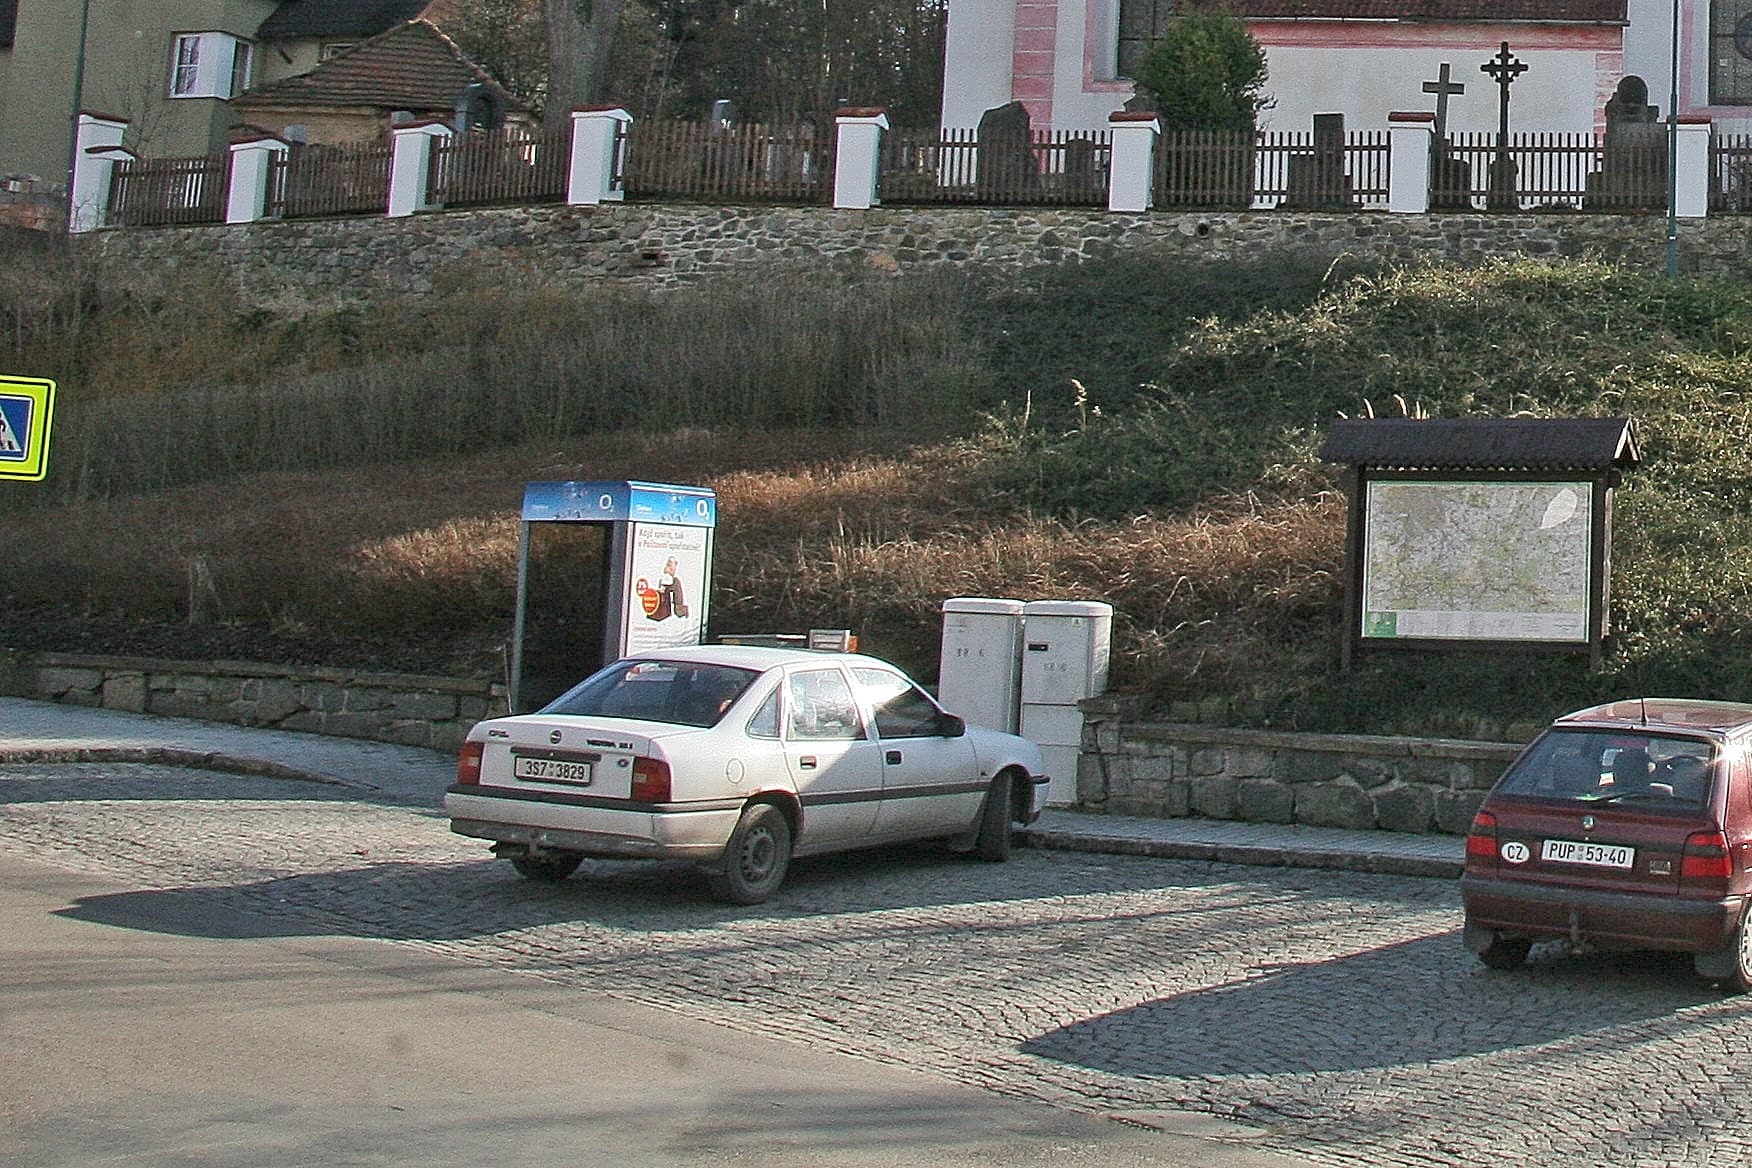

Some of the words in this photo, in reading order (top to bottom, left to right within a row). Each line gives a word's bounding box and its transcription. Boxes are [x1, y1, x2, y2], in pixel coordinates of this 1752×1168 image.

[526, 760, 548, 776] 3S7
[556, 763, 586, 780] 3829
[1507, 845, 1523, 860] CZ
[1549, 843, 1575, 860] PUP
[1585, 847, 1626, 864] 53-40
